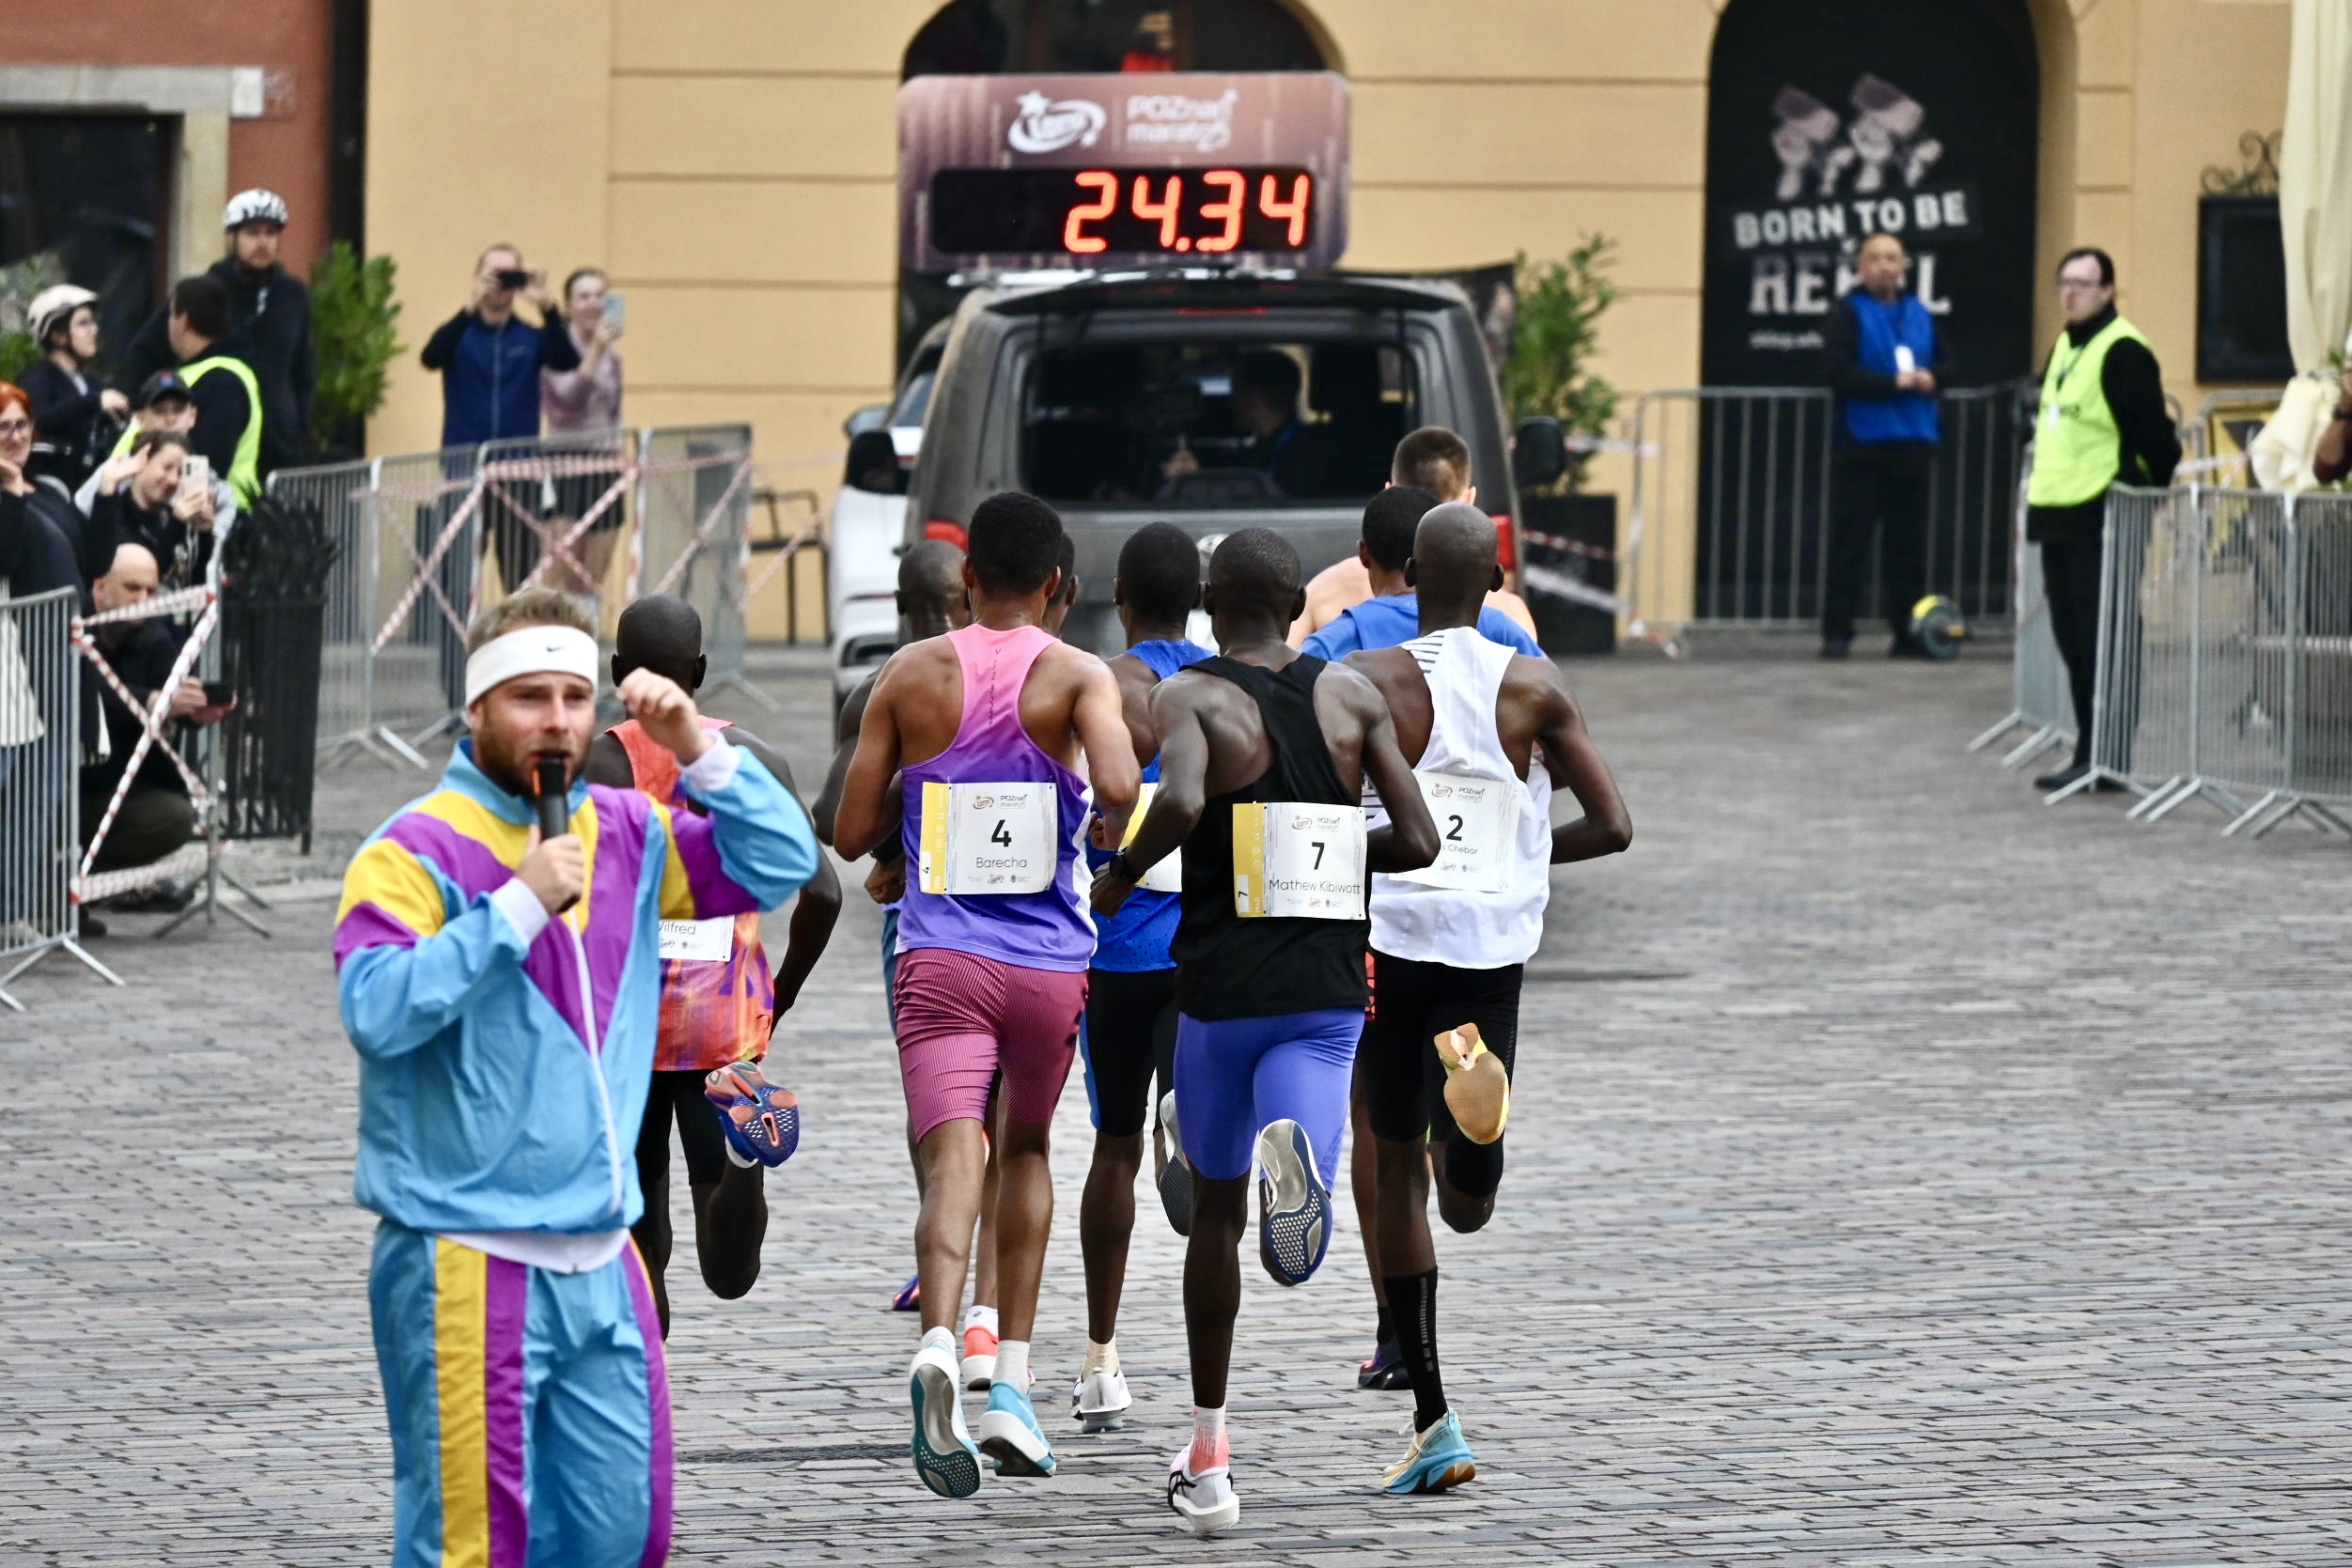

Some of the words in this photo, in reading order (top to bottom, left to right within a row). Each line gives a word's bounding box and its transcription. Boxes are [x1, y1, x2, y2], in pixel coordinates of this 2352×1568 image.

[1734, 203, 1846, 249] BORN
[1853, 198, 1906, 233] TO
[1913, 190, 1969, 229] BE
[1749, 252, 1952, 315] REL
[990, 819, 1012, 847] 4
[1446, 815, 1463, 842] 2
[975, 857, 1028, 869] Barecha
[1311, 841, 1325, 871] 7
[1269, 878, 1316, 892] Mathew
[1319, 880, 1361, 895] Kibiwott
